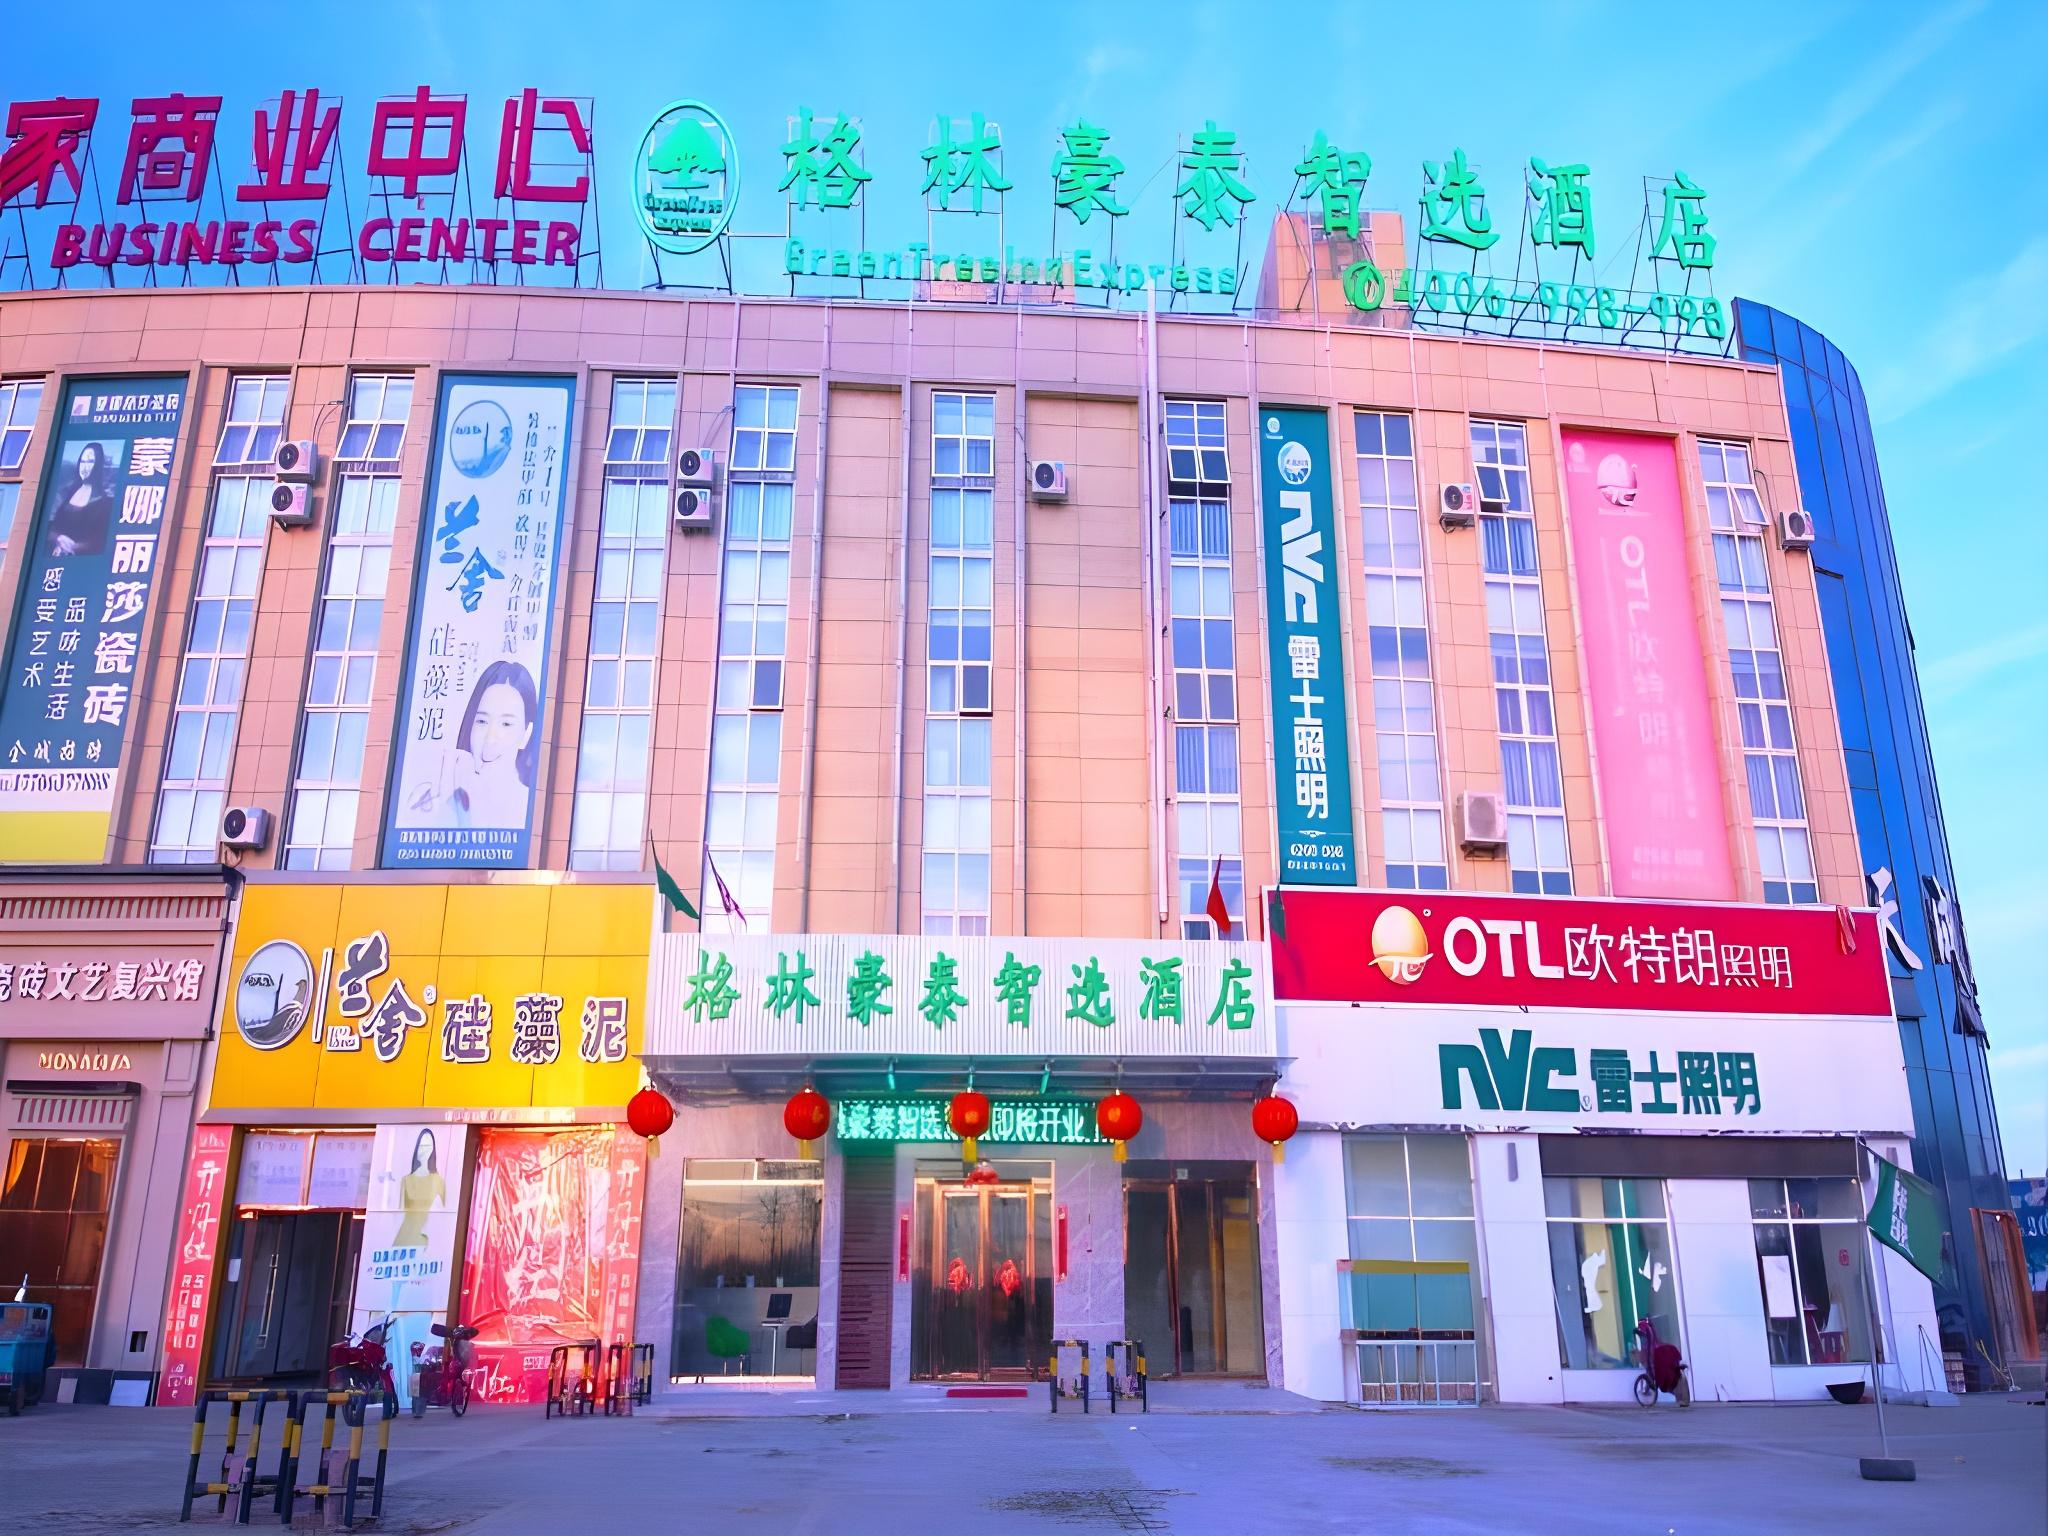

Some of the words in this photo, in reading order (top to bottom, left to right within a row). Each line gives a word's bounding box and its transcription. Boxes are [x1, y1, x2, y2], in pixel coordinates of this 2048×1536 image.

[0, 85, 594, 208] 家商业中心
[778, 104, 1719, 270] 格林豪泰智选酒店
[51, 219, 319, 268] BUSINESS
[359, 217, 580, 267] CENTER
[83, 437, 174, 726] 蒙娜丽莎瓷砖
[1288, 635, 1328, 819] 雷士照明
[1443, 916, 1565, 979] OTL
[442, 995, 628, 1063] 硅藻泥
[684, 949, 1256, 1030] 格林豪泰智选酒店
[1590, 1049, 1762, 1115] 雷士照明
